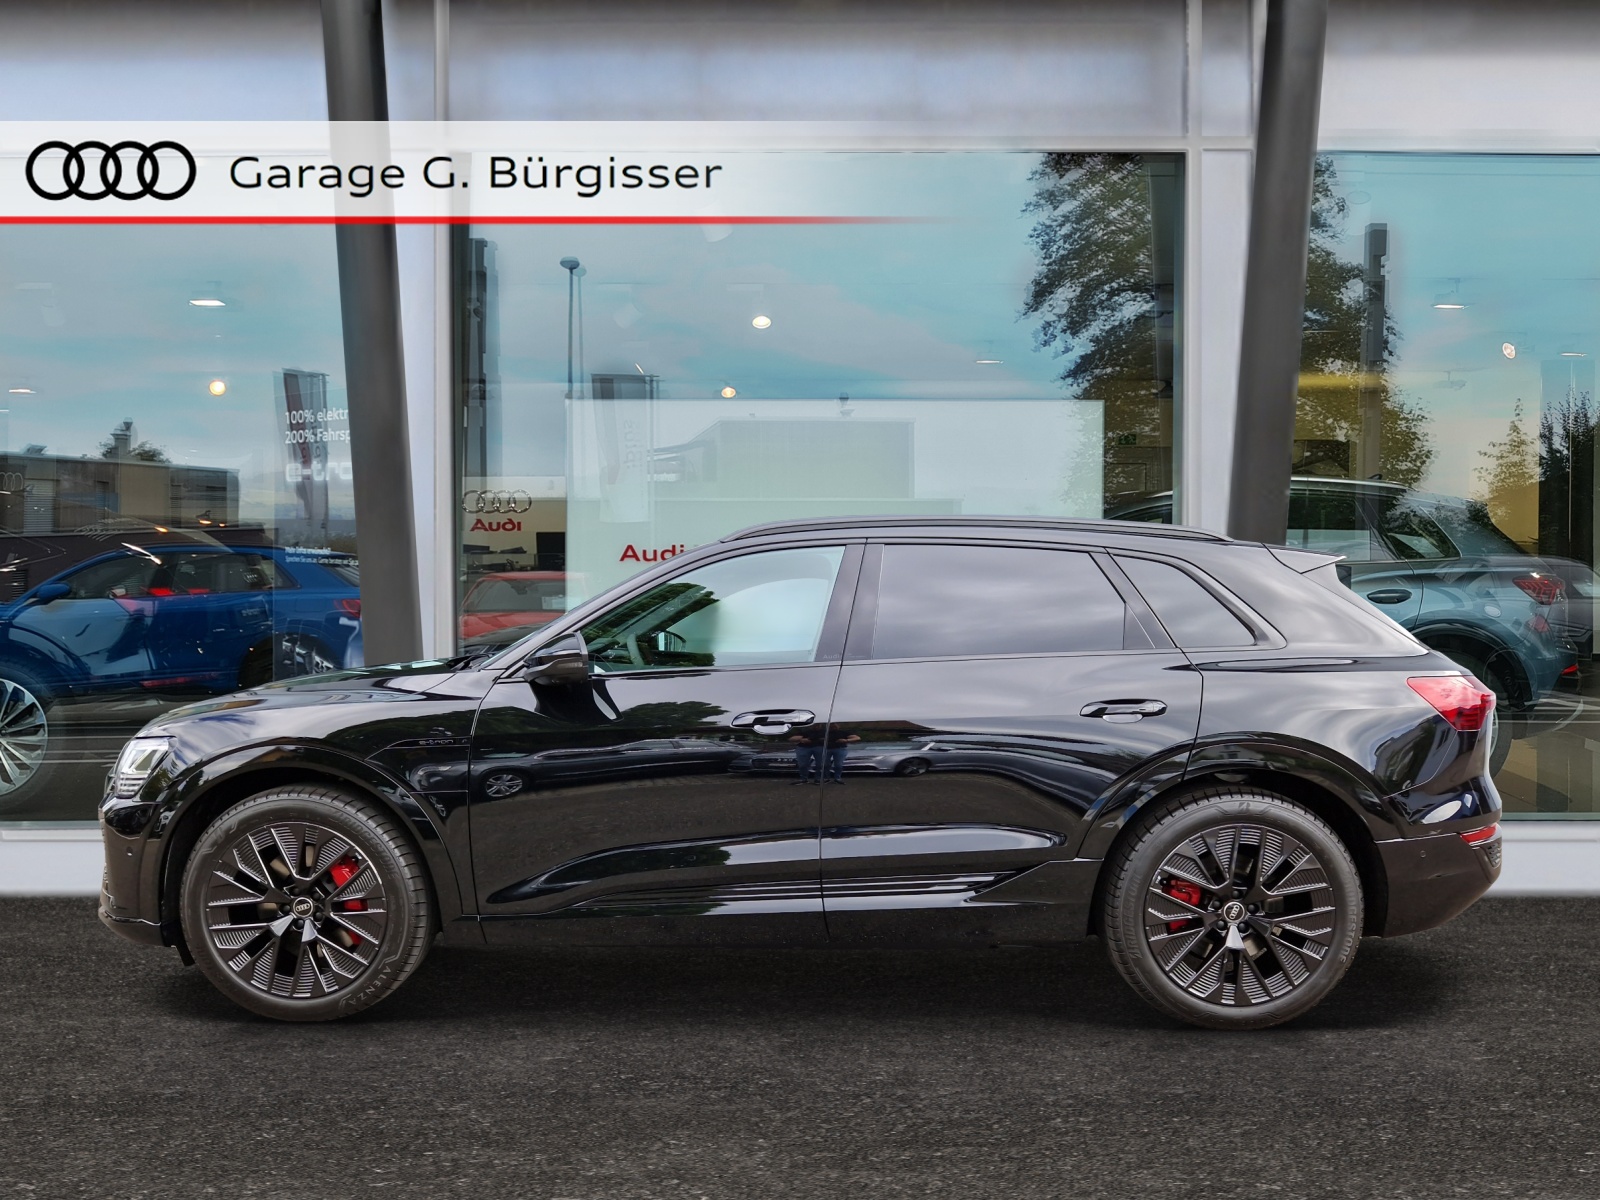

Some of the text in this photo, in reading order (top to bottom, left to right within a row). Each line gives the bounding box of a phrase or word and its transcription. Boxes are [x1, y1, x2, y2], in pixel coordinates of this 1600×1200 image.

[285, 410, 315, 424] 100%
[285, 429, 315, 444] 200%
[470, 518, 522, 532] Audi
[619, 544, 685, 562] Audi
[348, 965, 392, 1005] ALENZA
